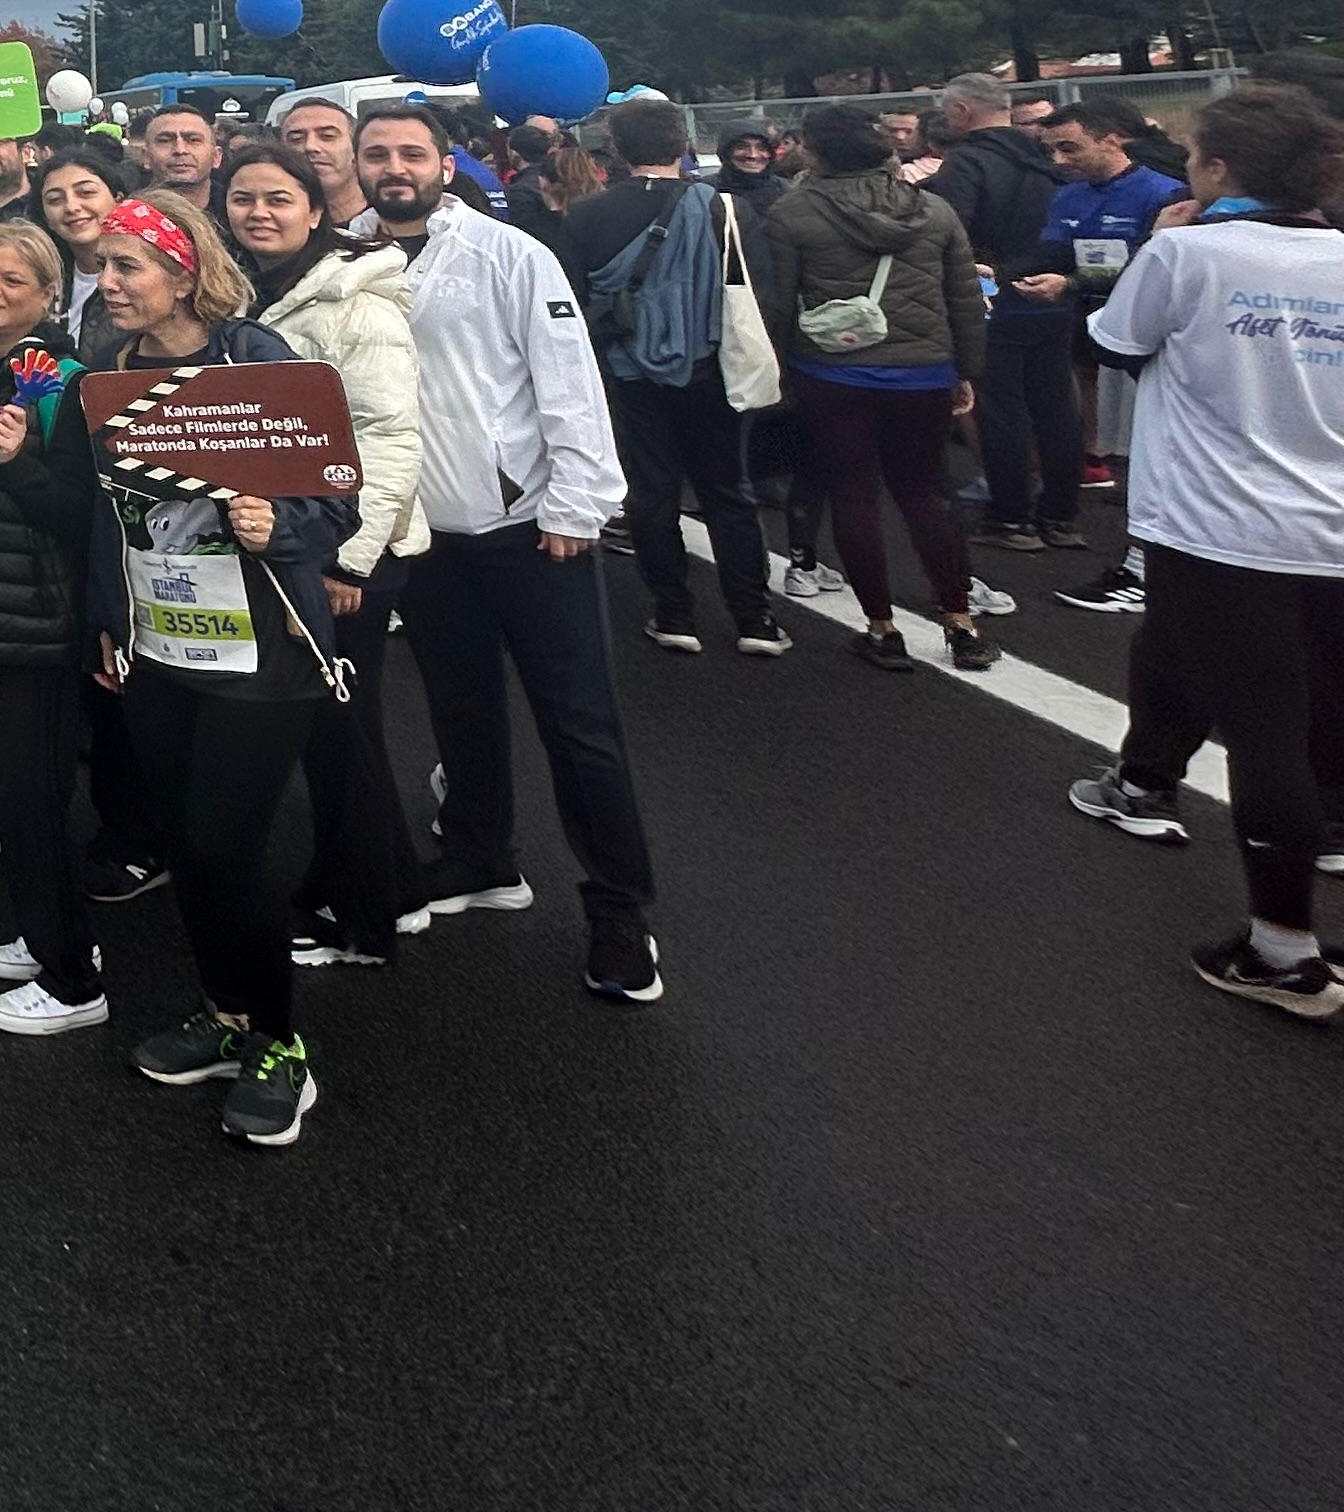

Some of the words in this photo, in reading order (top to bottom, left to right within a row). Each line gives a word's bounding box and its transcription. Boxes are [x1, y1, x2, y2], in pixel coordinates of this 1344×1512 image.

[163, 402, 262, 418] Kahramanlar
[128, 422, 183, 437] Sadece
[185, 420, 258, 434] Filmlerde
[262, 416, 308, 433] Değil,
[116, 439, 197, 453] Maratonda
[199, 437, 267, 452] Koşanlar
[271, 436, 292, 448] Da
[295, 434, 330, 447] Var!
[162, 610, 239, 636] 35514
